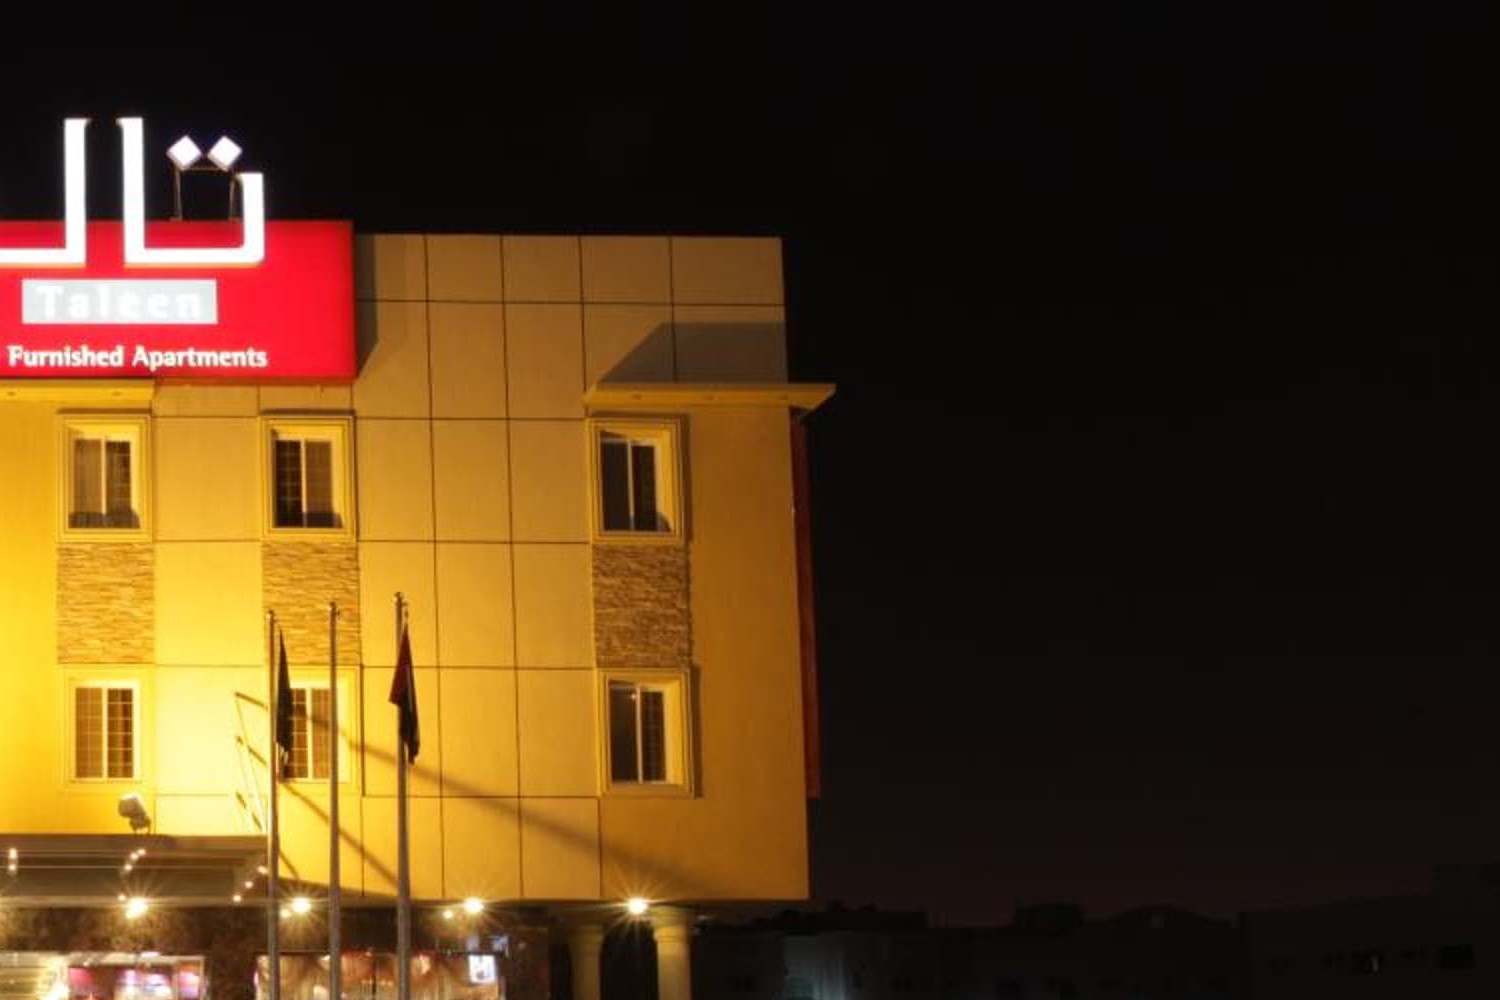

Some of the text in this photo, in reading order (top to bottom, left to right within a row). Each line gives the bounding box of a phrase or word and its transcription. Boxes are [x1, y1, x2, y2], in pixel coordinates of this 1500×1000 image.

[34, 282, 204, 321] Taleen
[6, 344, 269, 372] Furnished Apartments
